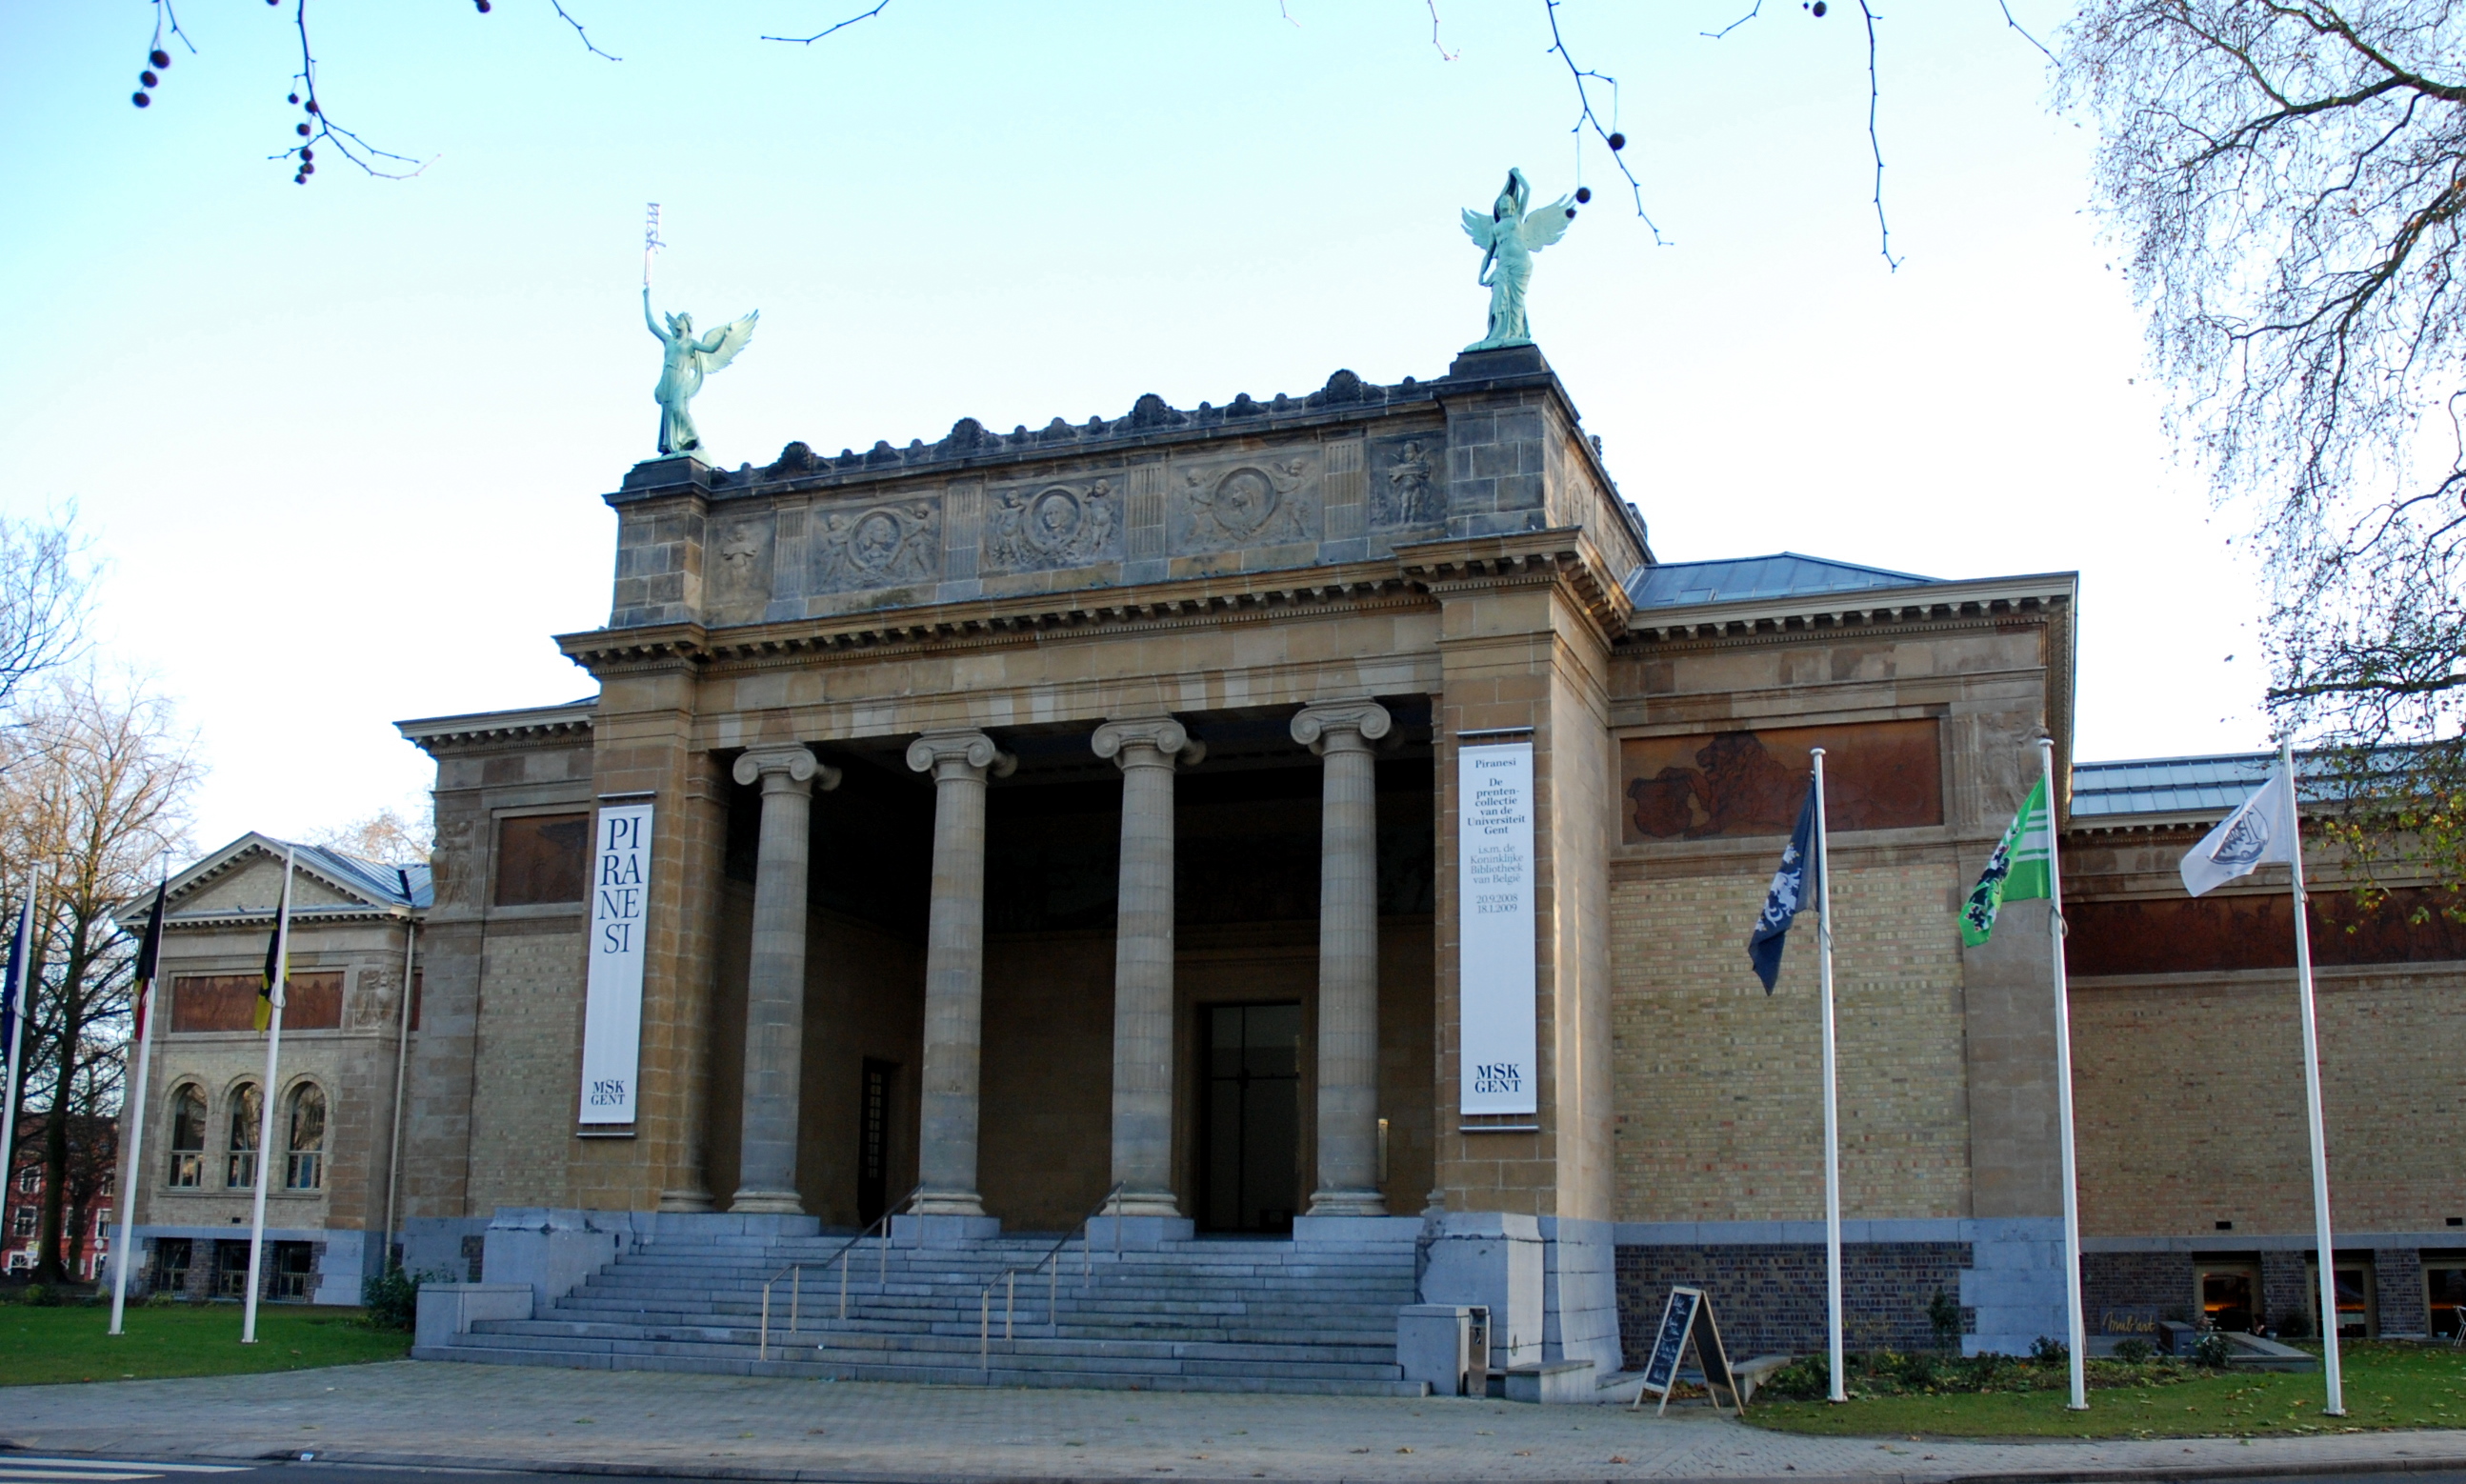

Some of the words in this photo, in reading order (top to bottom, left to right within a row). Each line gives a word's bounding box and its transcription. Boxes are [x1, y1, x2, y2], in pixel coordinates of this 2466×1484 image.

[1475, 757, 1516, 769] Piranesi
[1489, 777, 1503, 787] De
[1476, 788, 1520, 800] prenten-
[1474, 796, 1517, 807] collectie
[1500, 806, 1513, 814] de
[1467, 814, 1526, 826] Universiteit
[606, 816, 642, 851] PI
[1484, 826, 1509, 835] Gent
[1503, 843, 1515, 852] de
[1470, 853, 1524, 864] Koninklijke
[600, 853, 643, 886] RA
[1471, 863, 1524, 874] Bibliotheek
[1493, 873, 1521, 885] België
[598, 888, 640, 920] NE
[1475, 893, 1519, 904] 20.9.2008
[1477, 903, 1518, 913] 18.1.2009
[603, 923, 631, 954] SI
[1476, 1062, 1521, 1080] MSK
[591, 1079, 626, 1094] MSK
[1474, 1079, 1522, 1094] GENT
[591, 1093, 626, 1106] GENT
